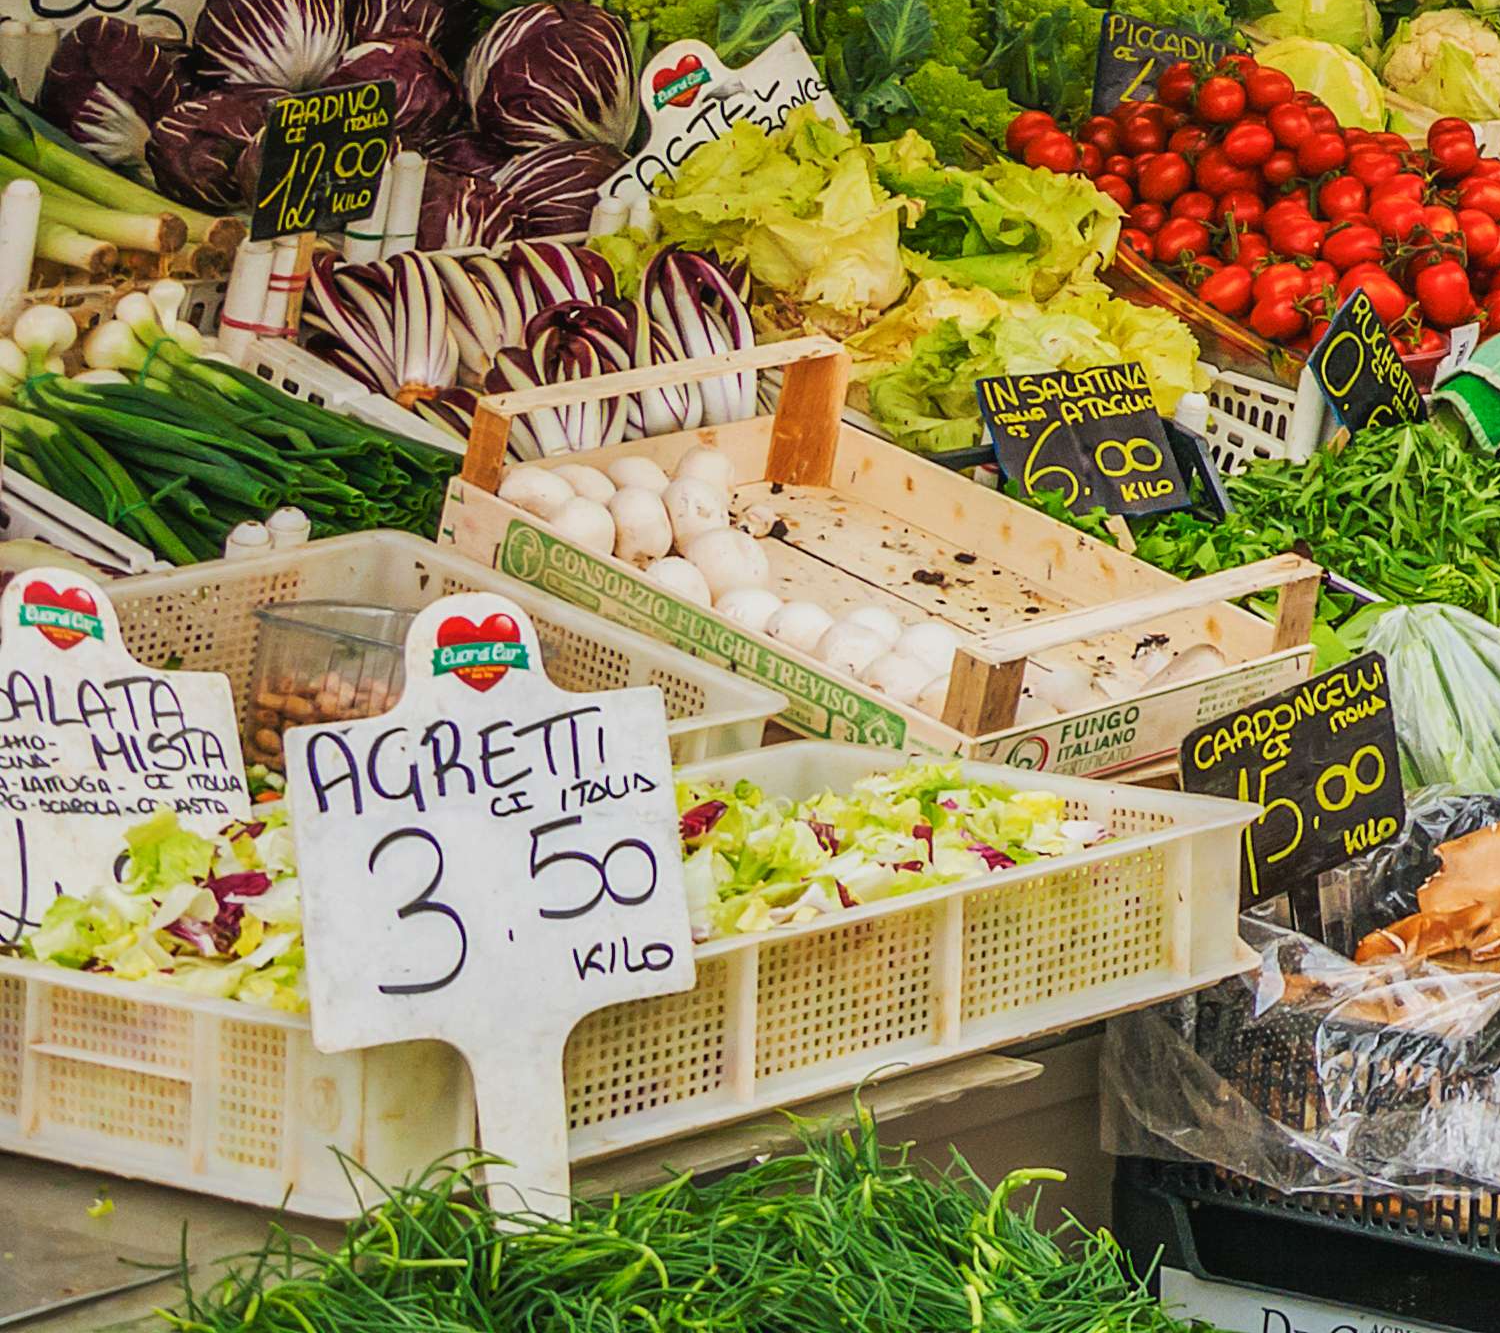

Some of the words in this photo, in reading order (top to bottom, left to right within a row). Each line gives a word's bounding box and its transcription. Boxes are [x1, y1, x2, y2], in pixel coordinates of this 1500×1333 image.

[277, 84, 381, 127] TARDIVO
[1120, 479, 1175, 502] KILO
[549, 546, 671, 621] CONSORZIO
[672, 606, 759, 669] FUNGHI
[765, 654, 861, 719] TREVISO
[1059, 705, 1141, 745] FUNGO
[1192, 661, 1385, 771] CARDONCELLI
[91, 727, 228, 773] MISTA
[306, 705, 605, 817] AGRETTI
[1056, 726, 1137, 763] ITALIANO
[1343, 816, 1399, 857] KILO
[572, 935, 674, 982] KILO
